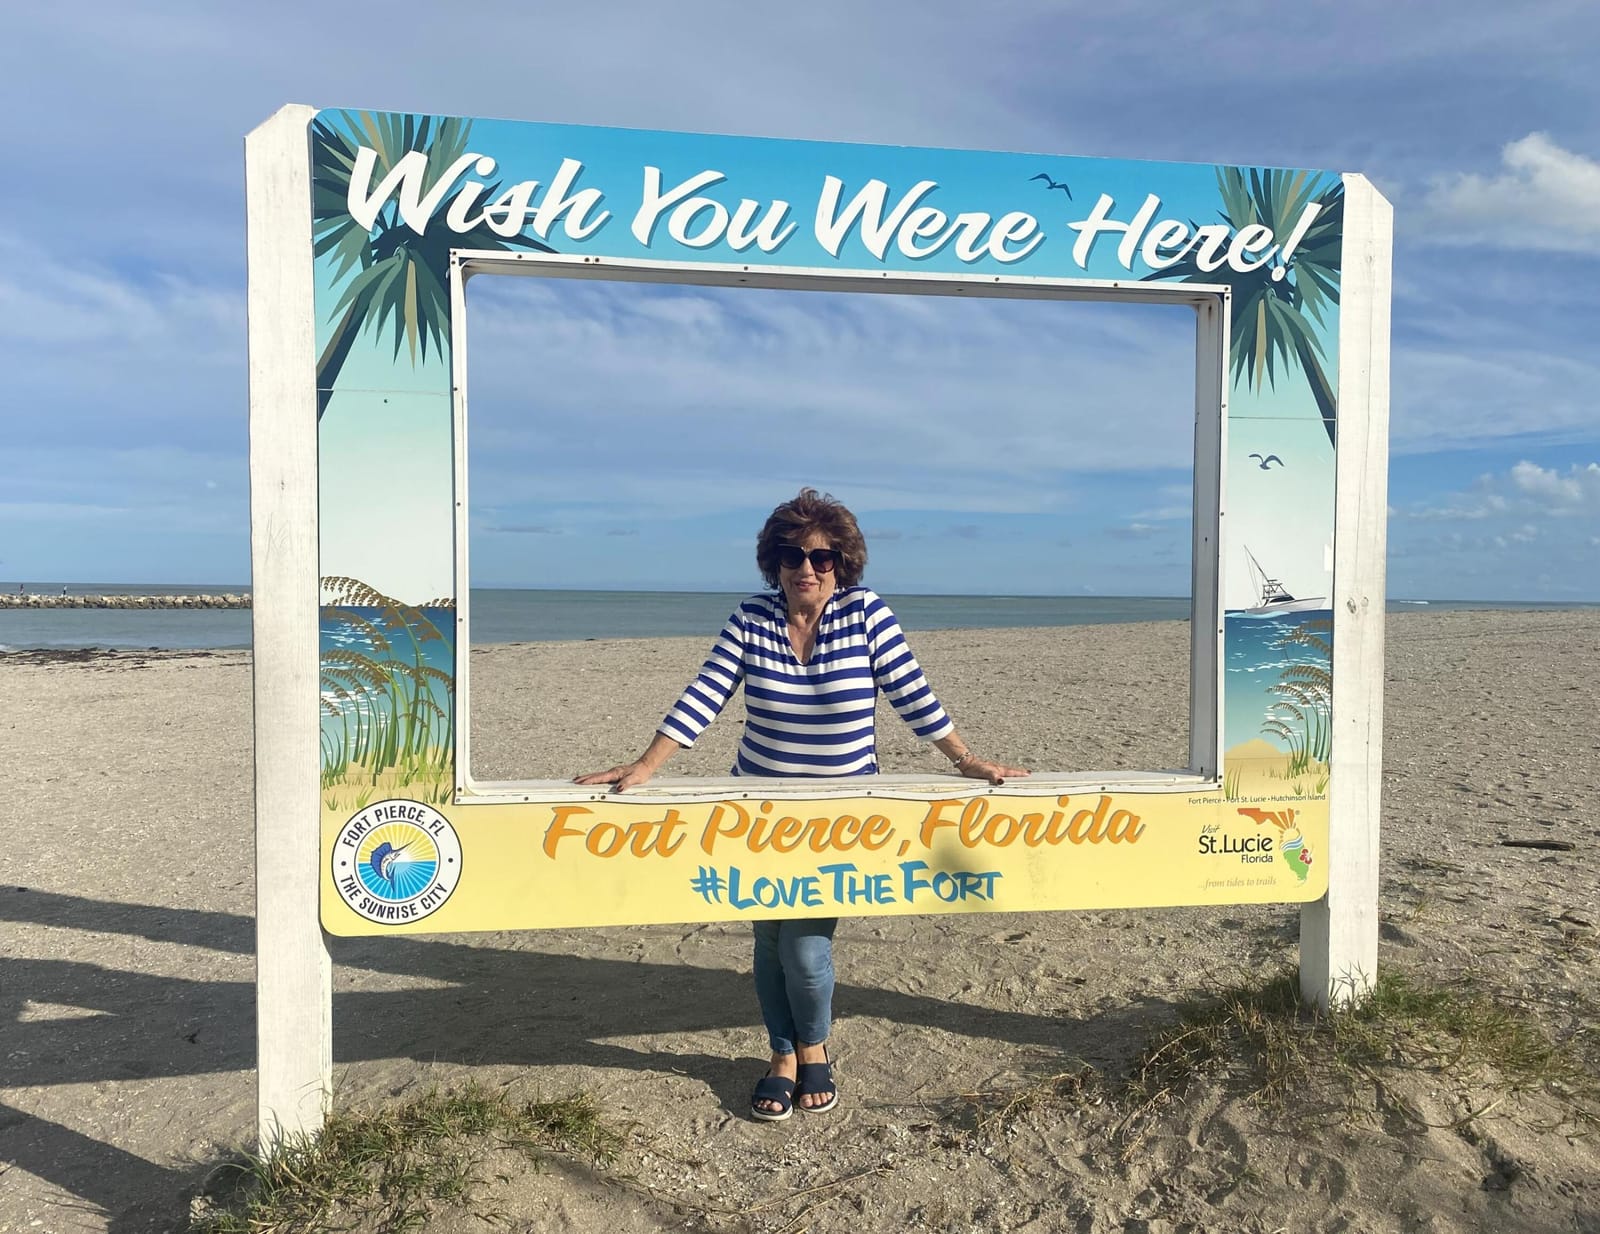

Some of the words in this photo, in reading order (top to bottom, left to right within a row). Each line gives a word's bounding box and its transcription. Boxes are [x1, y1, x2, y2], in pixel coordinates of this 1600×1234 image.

[346, 145, 610, 238] Wish
[630, 165, 798, 253] You
[814, 175, 1045, 262] Were
[1066, 192, 1324, 283] Here!
[1188, 797, 1202, 805] Fort
[1202, 796, 1222, 804] Pierce
[1241, 795, 1249, 803] St.
[1250, 794, 1267, 803] Lucie
[1271, 791, 1307, 802] Hutchinson
[1307, 790, 1326, 801] Island
[342, 815, 372, 848] FORT
[374, 805, 426, 826] PIERCE,
[428, 819, 445, 837] FL
[542, 805, 688, 860] Fort
[700, 799, 911, 857] Pierce,
[919, 795, 1146, 850] Florida
[1201, 824, 1220, 834] Visit
[1241, 854, 1273, 864] Florida
[1226, 877, 1245, 887] tides
[1246, 878, 1255, 886] to
[1256, 876, 1277, 886] trails
[340, 874, 362, 901] THE
[358, 897, 419, 919] SUNRISE
[420, 882, 448, 910] CITY
